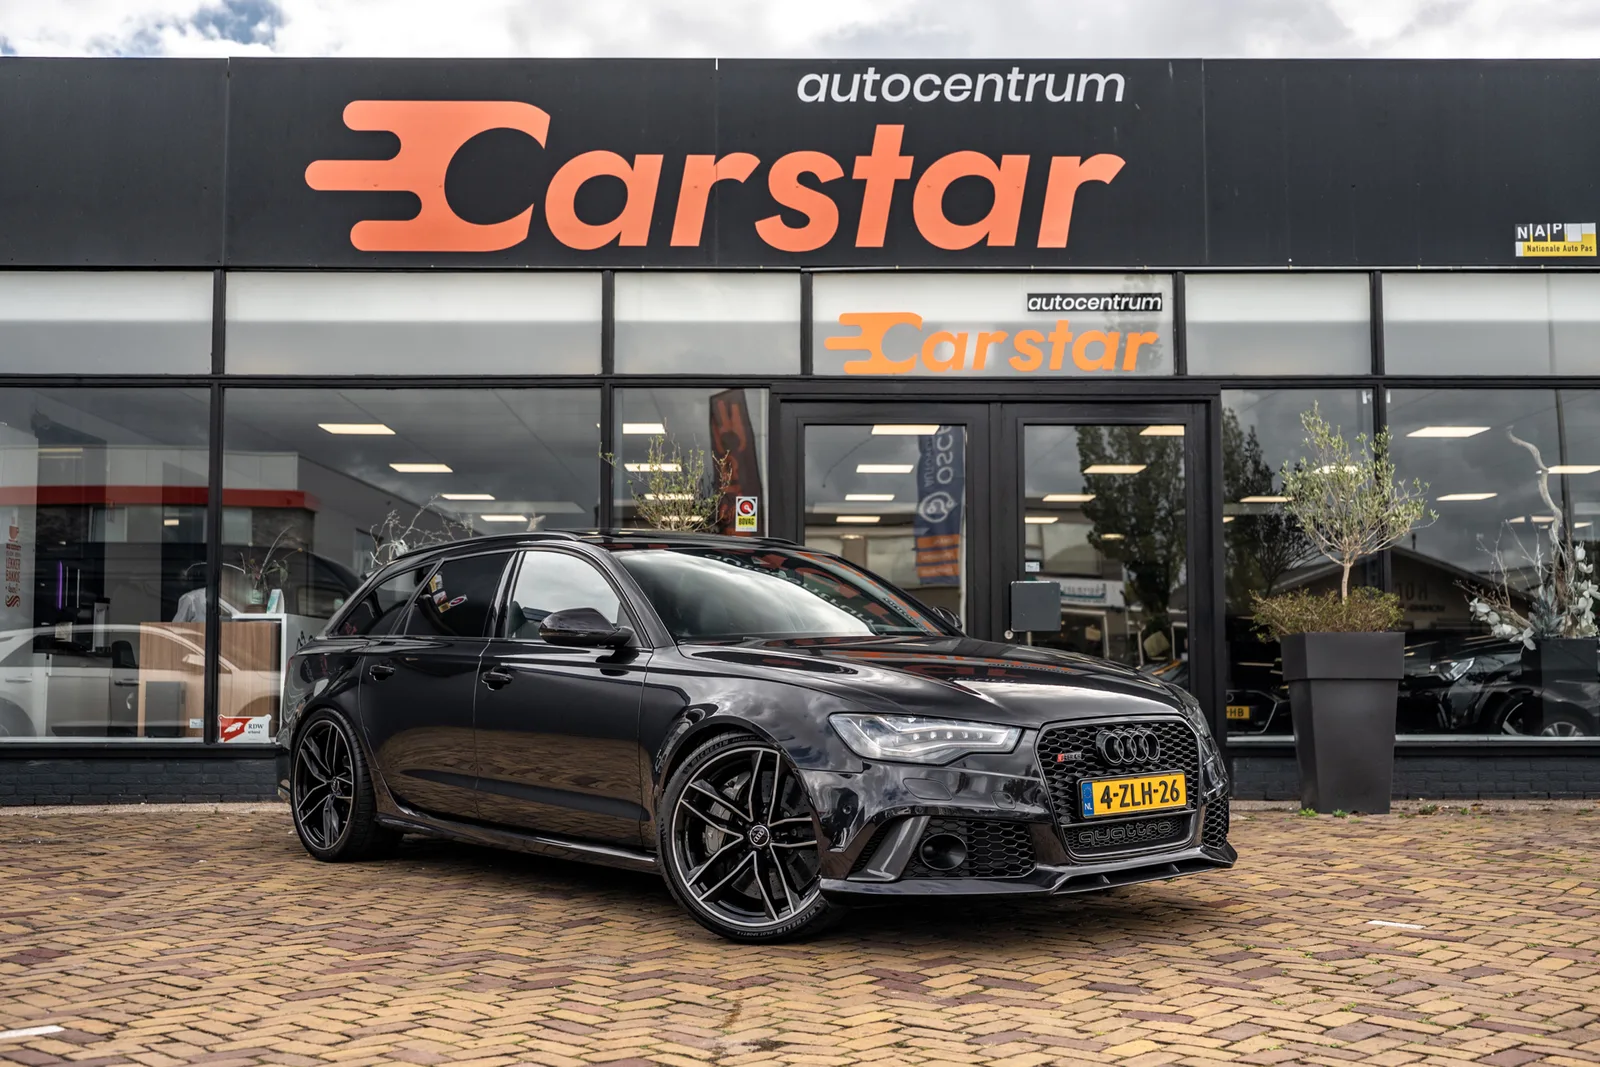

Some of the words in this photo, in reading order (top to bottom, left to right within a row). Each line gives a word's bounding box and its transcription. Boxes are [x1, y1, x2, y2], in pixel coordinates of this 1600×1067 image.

[797, 66, 1125, 104] autocentrum
[305, 100, 1126, 252] Carstar
[1526, 244, 1561, 253] Nationale
[1562, 244, 1579, 253] Auto
[1580, 244, 1593, 252] Pas
[1027, 293, 1162, 311] autocentrum
[824, 312, 1159, 374] Carstar
[738, 517, 755, 526] BOVAG
[1085, 803, 1093, 811] NL
[1101, 779, 1181, 810] 4-ZLH-26
[1079, 821, 1174, 847] quattro
[776, 908, 817, 934] MICHELIN
